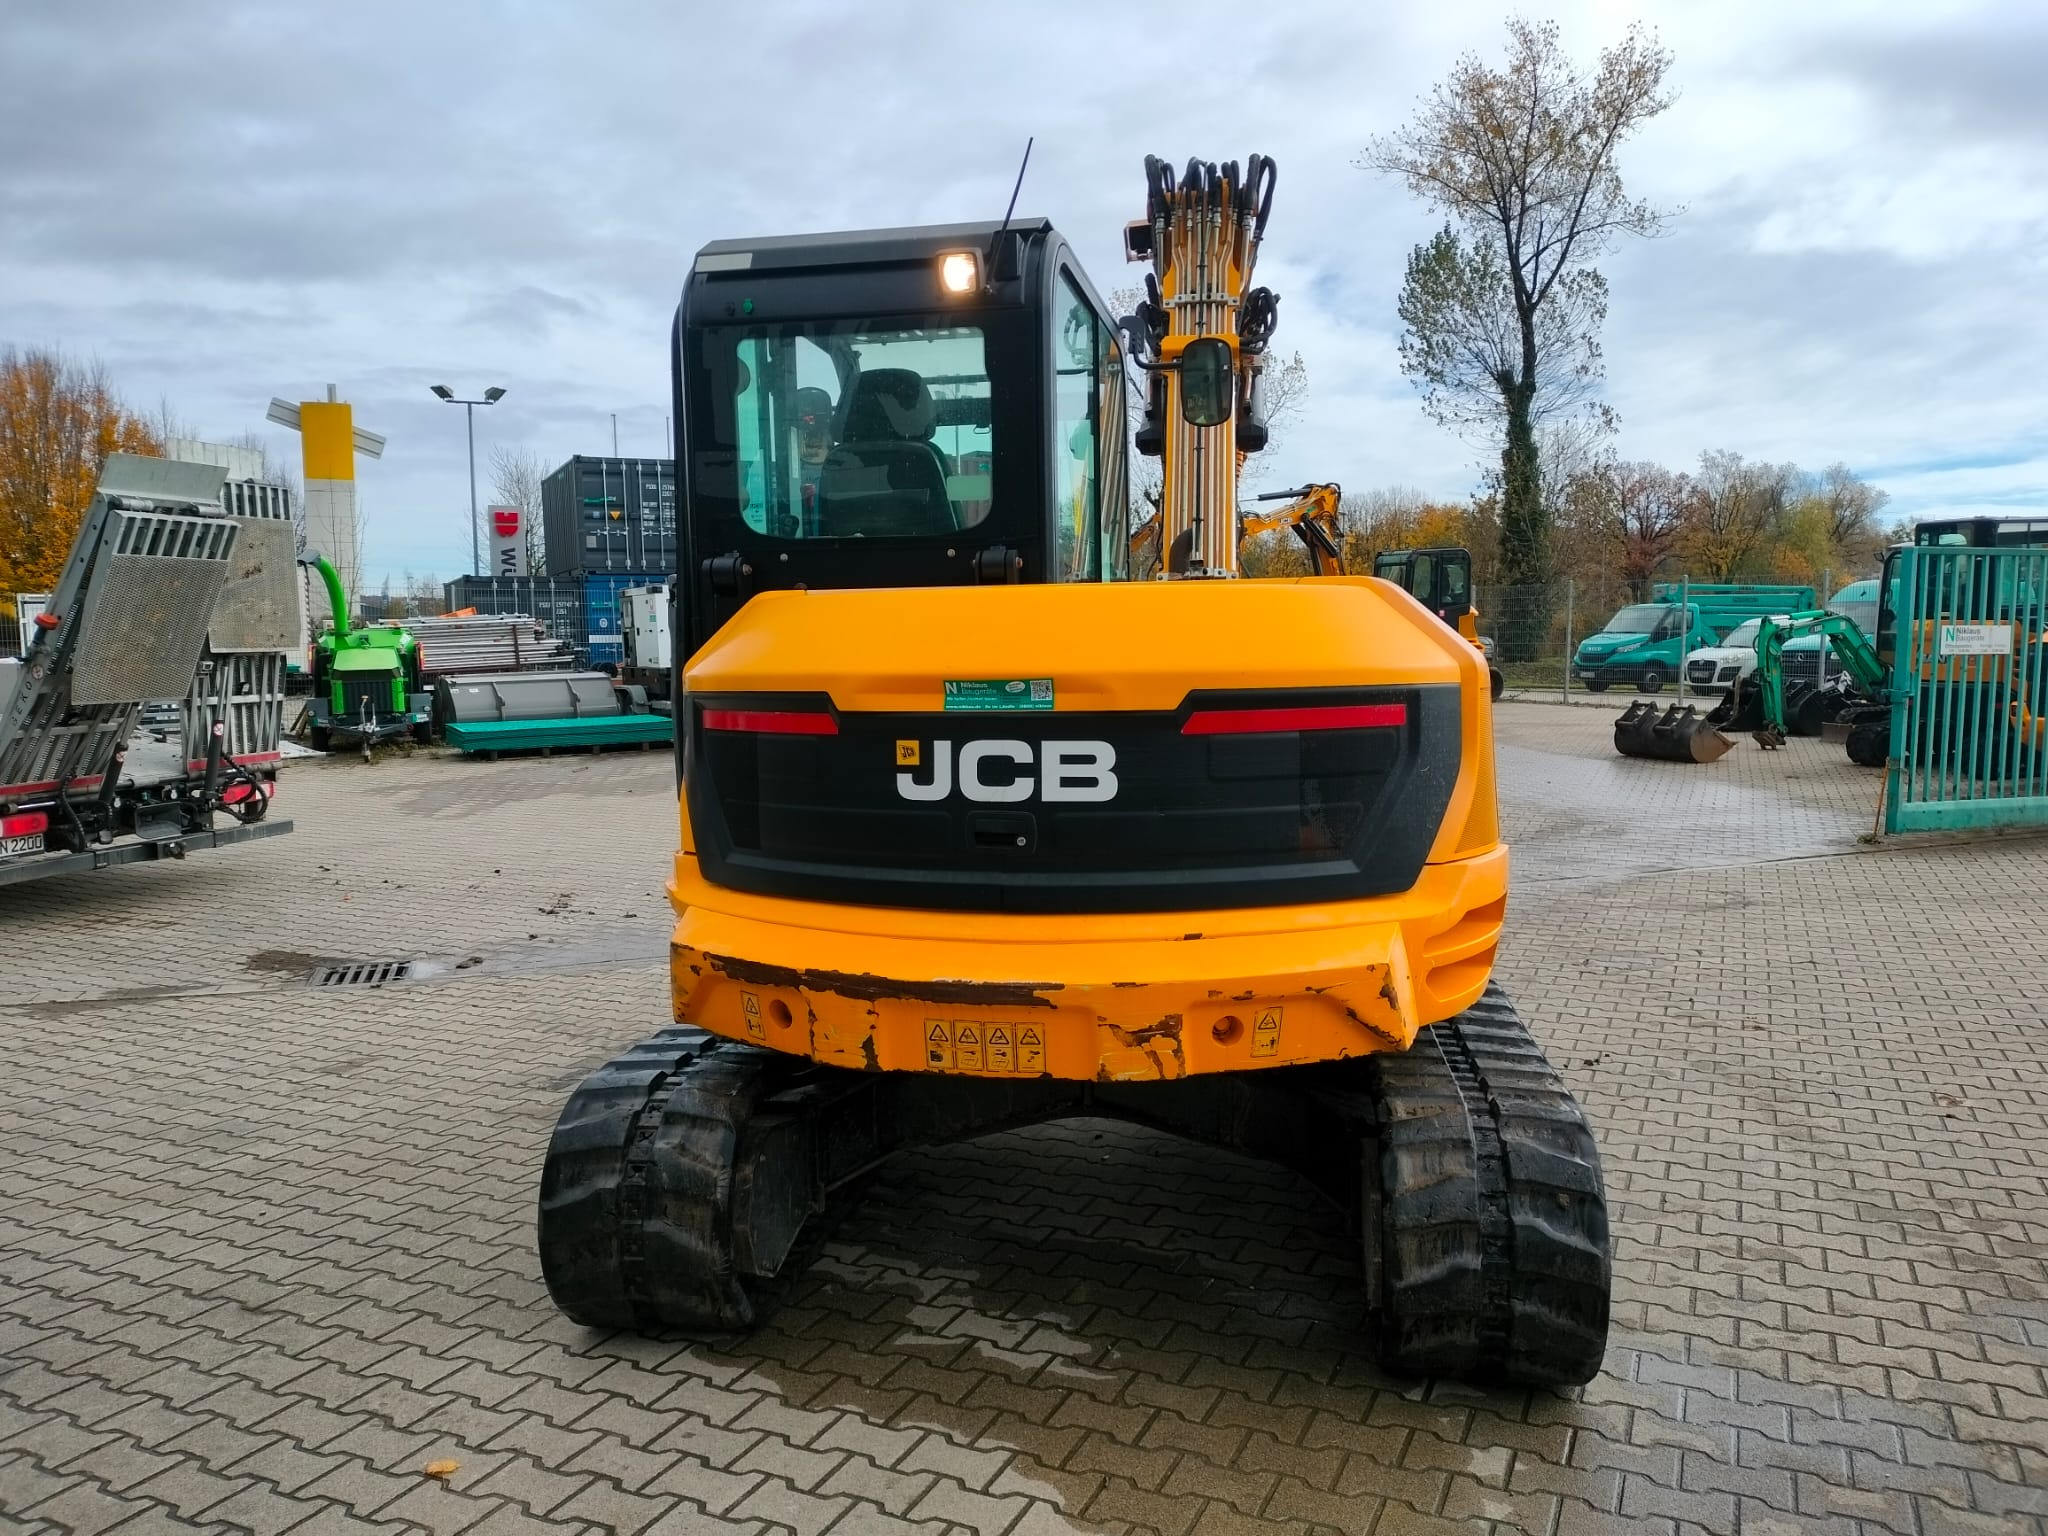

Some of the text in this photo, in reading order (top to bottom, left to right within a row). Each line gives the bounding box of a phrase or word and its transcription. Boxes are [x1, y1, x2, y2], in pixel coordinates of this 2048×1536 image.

[1956, 626, 1981, 635] Niklaus
[945, 682, 958, 695] N
[896, 739, 1119, 802] JCB
[11, 835, 42, 852] 2200
